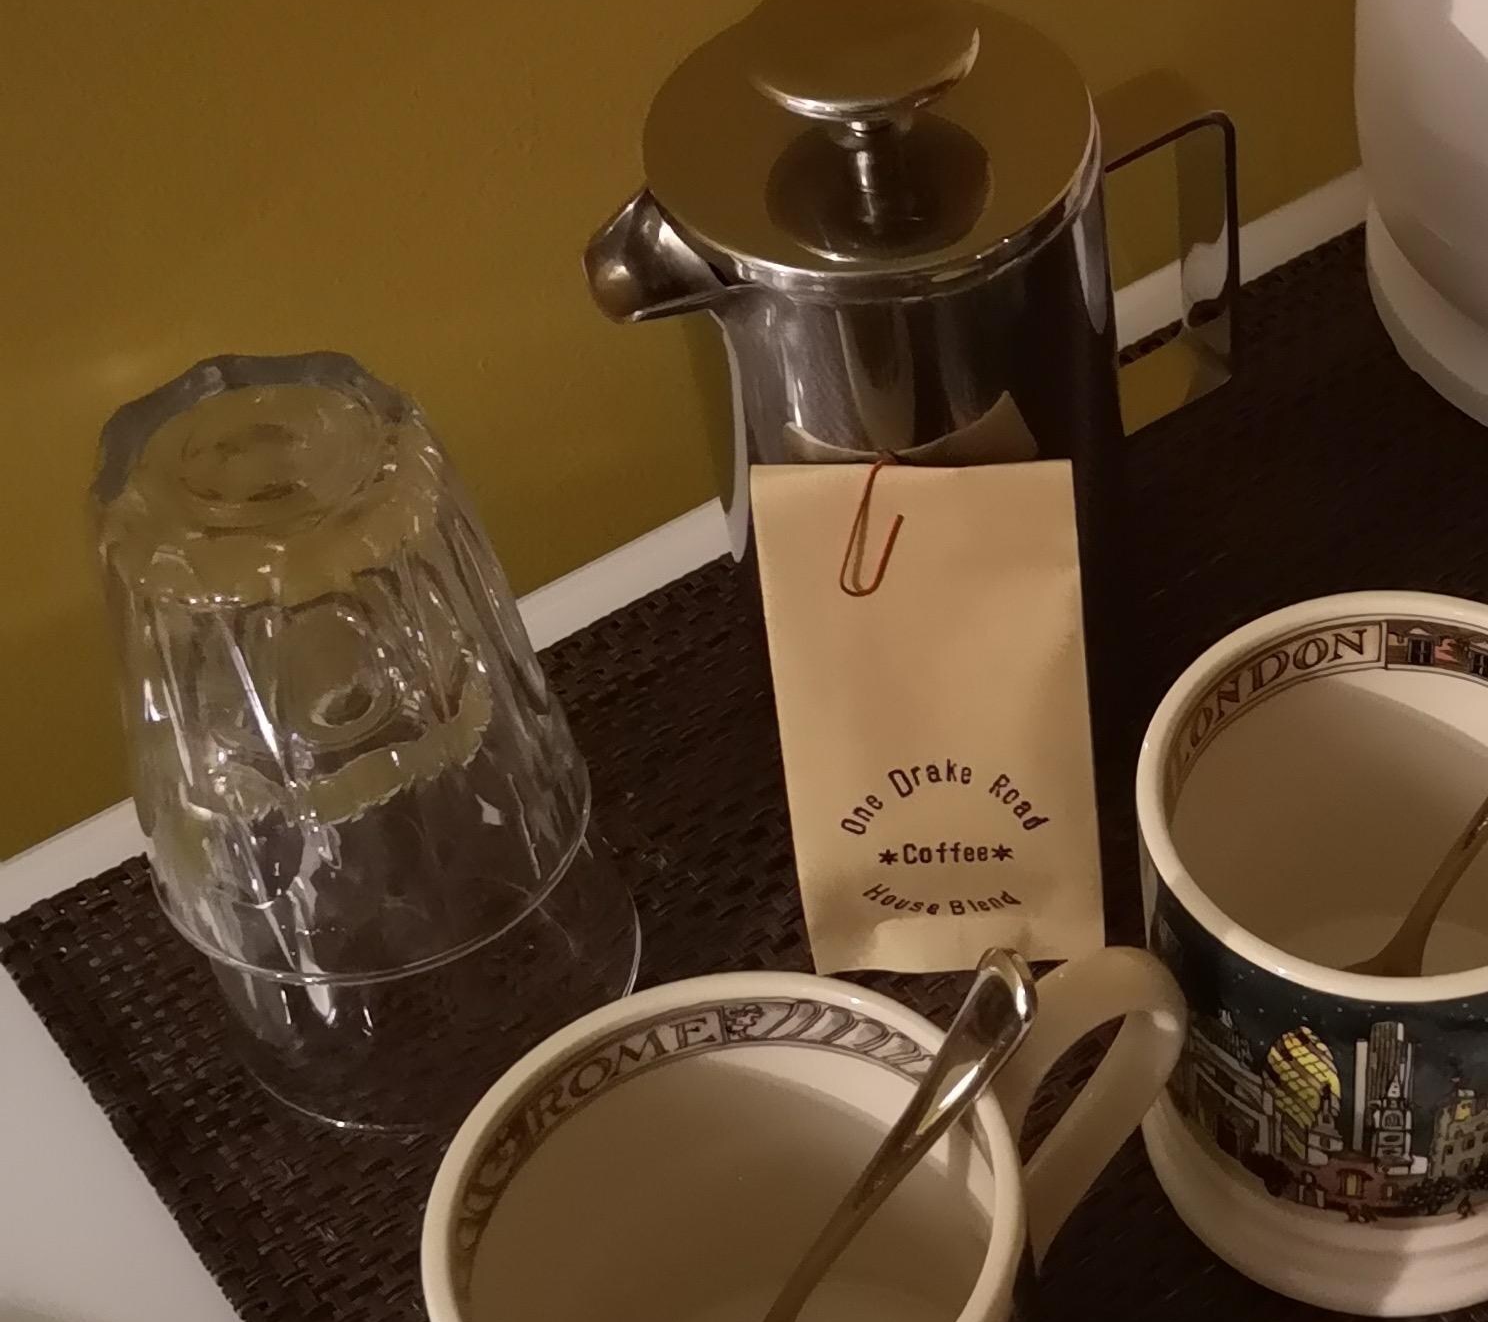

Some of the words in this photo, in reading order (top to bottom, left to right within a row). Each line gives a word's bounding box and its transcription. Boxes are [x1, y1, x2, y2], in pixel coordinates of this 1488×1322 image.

[1172, 628, 1368, 765] LONDON
[841, 794, 884, 835] One
[887, 758, 973, 798] Drake
[988, 773, 1050, 831] Road
[862, 883, 940, 916] House
[949, 890, 1022, 916] Blend
